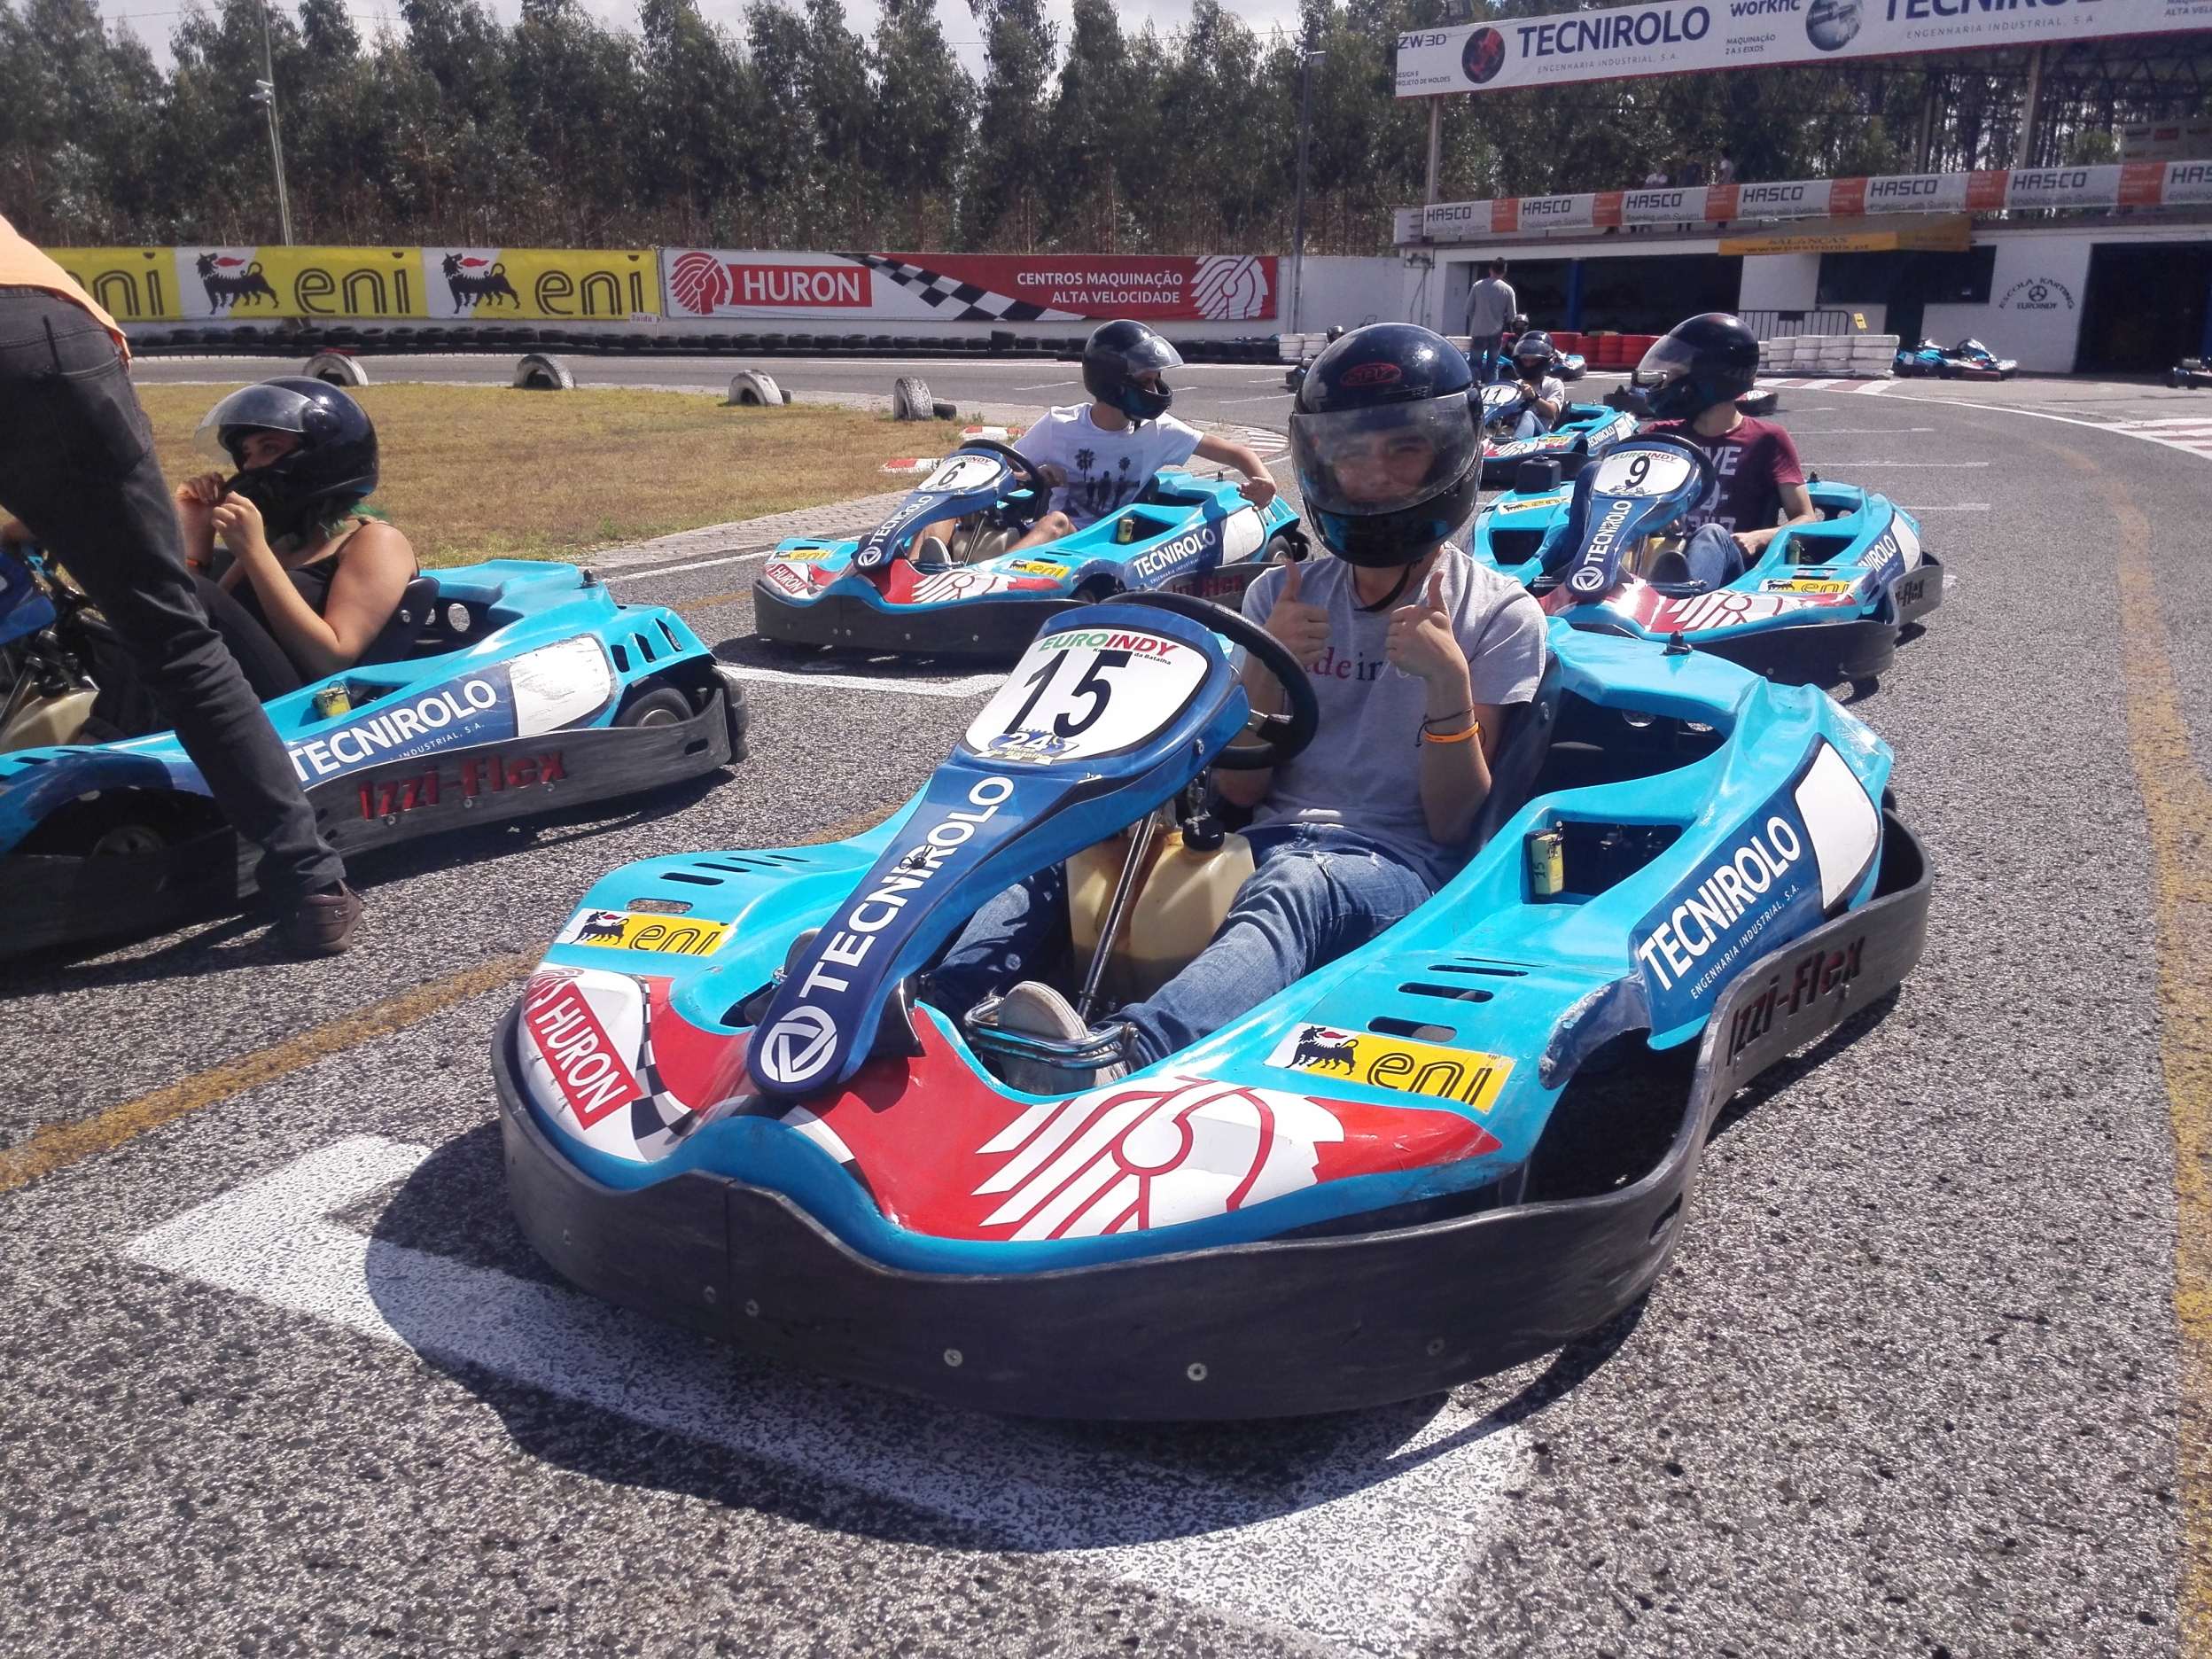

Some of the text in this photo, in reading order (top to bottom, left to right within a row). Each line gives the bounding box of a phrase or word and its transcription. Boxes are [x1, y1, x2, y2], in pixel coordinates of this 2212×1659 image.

[1398, 34, 1446, 50] ZW3D
[1517, 6, 1710, 58] TECNIROLO
[1907, 25, 1982, 39] ENGENHARIA
[1742, 186, 1804, 203] HASCO
[1870, 179, 1938, 197] HASCO
[2013, 172, 2087, 190] HASCO
[1427, 206, 1472, 222] HASCO
[1523, 199, 1571, 215] HASCO
[1626, 193, 1682, 209] HASCO
[66, 252, 164, 316] ni
[294, 252, 410, 315] eni
[534, 254, 644, 315] eni
[744, 270, 860, 302] HURON
[1016, 269, 1183, 289] CENTROS MAQUINAÇÃO
[2040, 277, 2076, 309] KARTING
[1052, 291, 1180, 304] ALTA VELOCIDADE
[1483, 388, 1501, 401] 11
[1613, 452, 1678, 461] EUROINDY
[938, 461, 966, 487] 6
[1625, 456, 1650, 490] 9
[868, 495, 934, 546] TECNIOLO
[1584, 500, 1632, 565] TECNIROLO
[1133, 528, 1216, 579] TECNIROLO
[769, 565, 805, 592] HURON
[1801, 580, 1851, 594] eni
[1038, 633, 1179, 657] EUROINDY
[1144, 654, 1172, 666] Batalha
[1003, 649, 1133, 738] 15
[289, 679, 496, 782] TECNIROLO
[358, 751, 567, 821] Izzi-Flex
[1532, 861, 1546, 879] 15
[798, 776, 1014, 998] TECNIROLO
[1639, 815, 1801, 991] TECNIROLO
[628, 922, 729, 955] eni
[1690, 945, 1740, 1000] ENGENHARIA
[1785, 884, 1800, 901] S.A.
[1726, 936, 1865, 1067] Izzi-Flex
[534, 996, 629, 1115] HURON
[1367, 1053, 1498, 1106] eni
